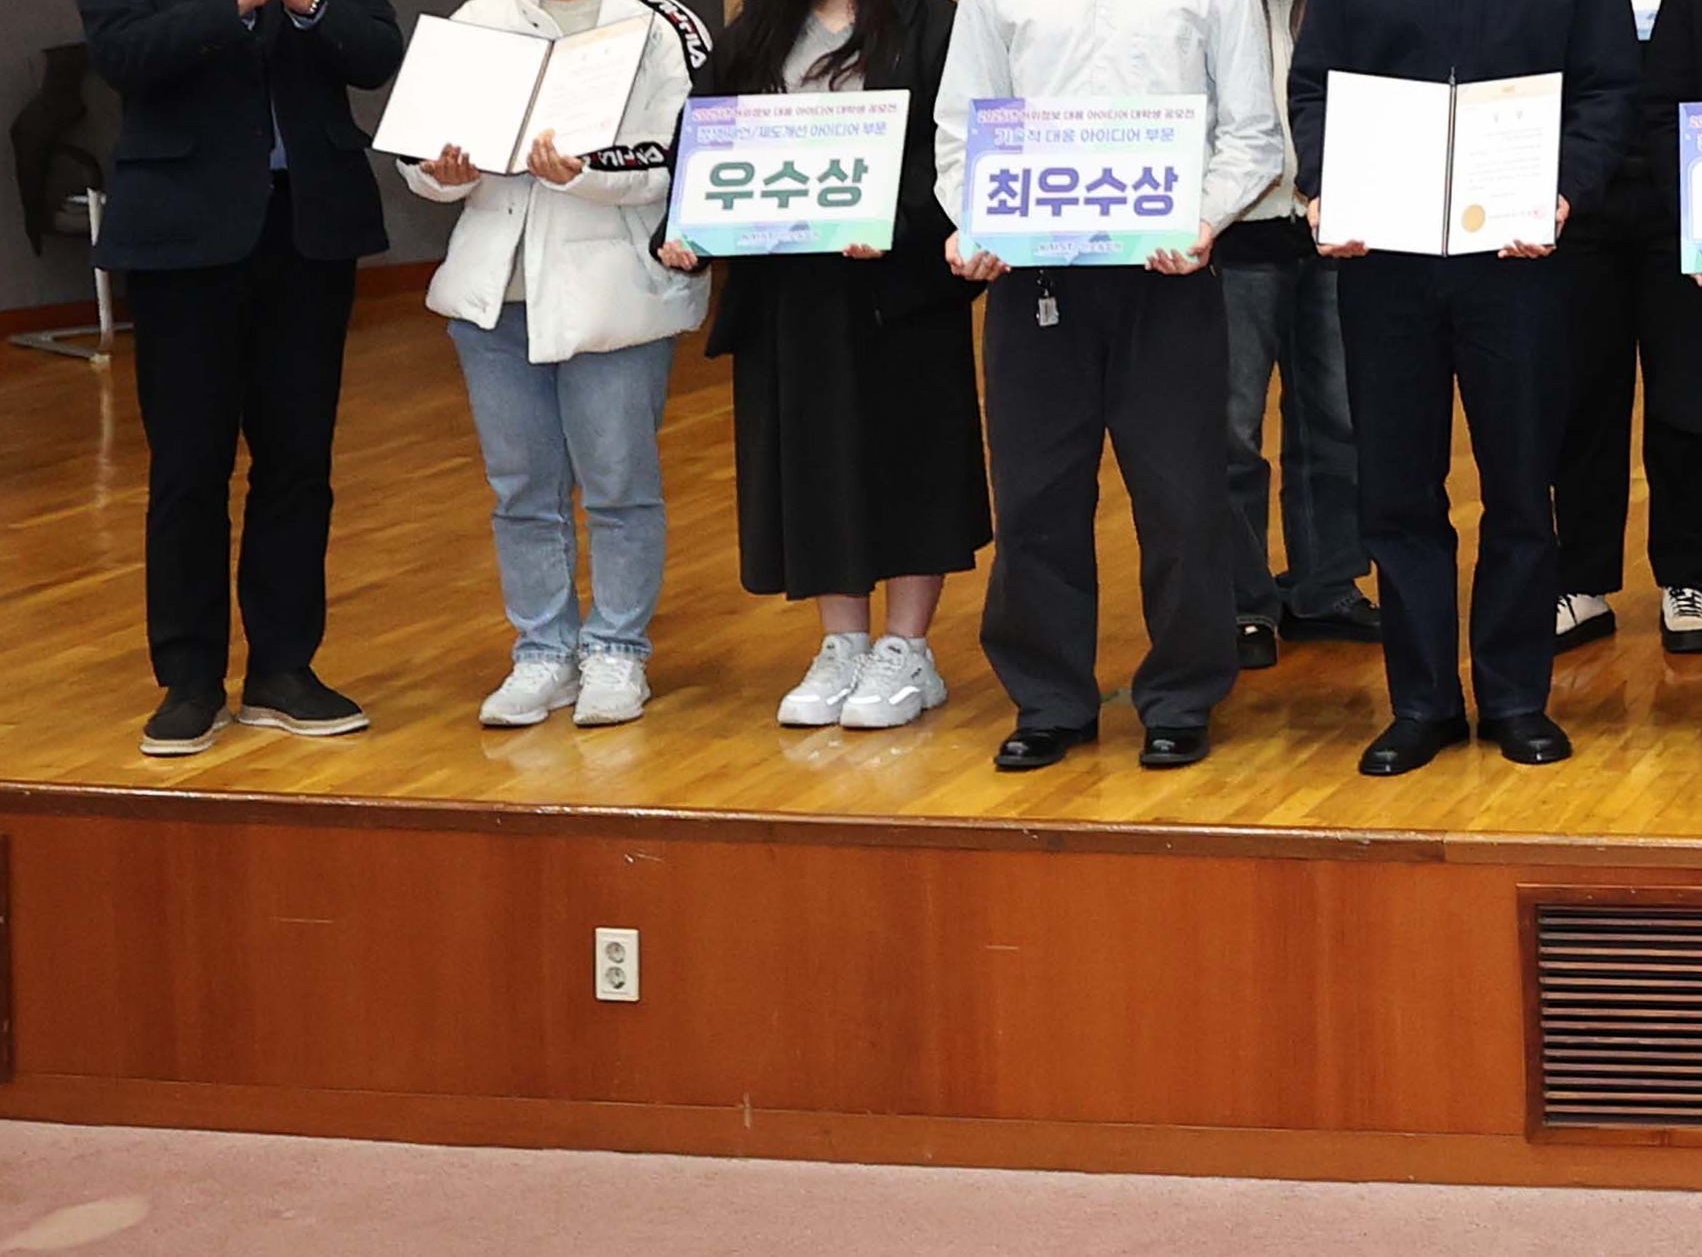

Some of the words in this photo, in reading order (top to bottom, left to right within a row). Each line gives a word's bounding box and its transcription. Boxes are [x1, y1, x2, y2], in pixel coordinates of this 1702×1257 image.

[1081, 129, 1140, 142] 아이디어
[706, 159, 868, 209] 우수상
[986, 167, 1178, 217] 최우수상
